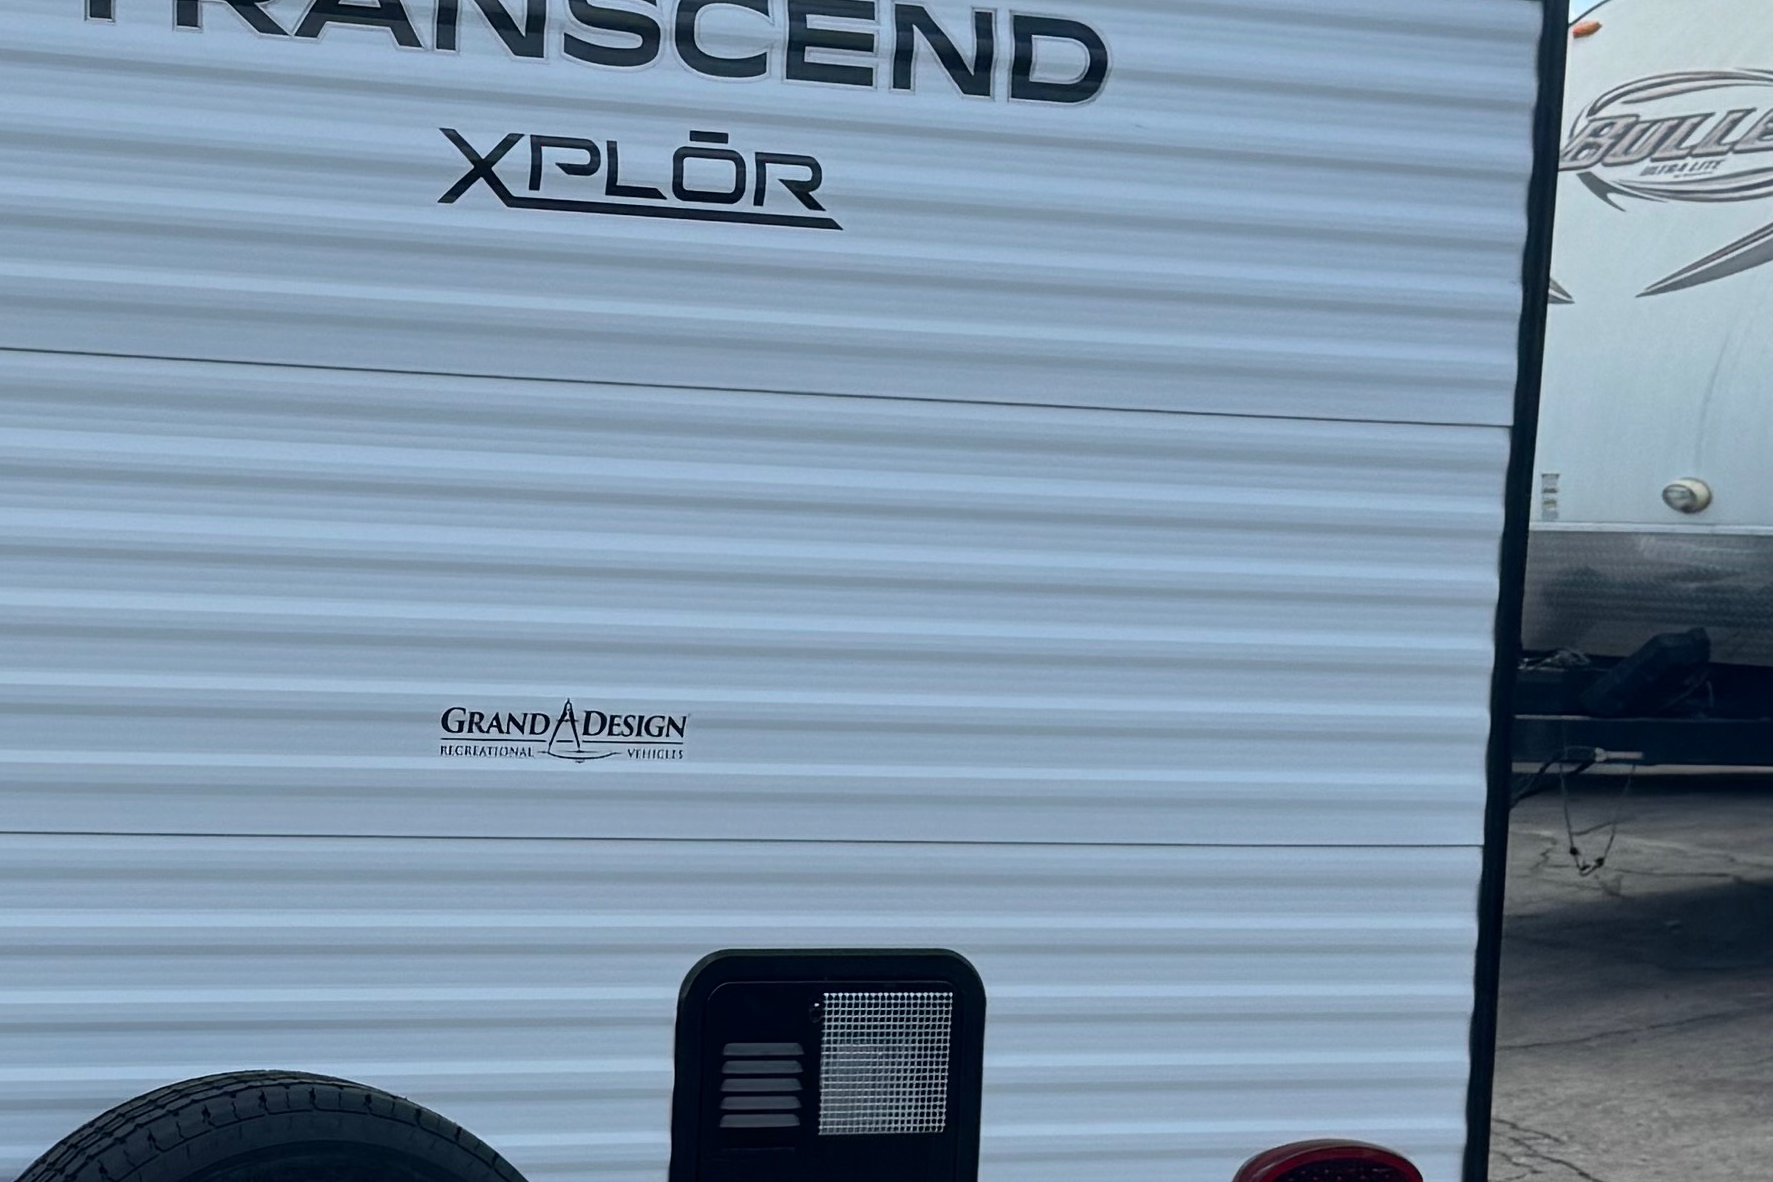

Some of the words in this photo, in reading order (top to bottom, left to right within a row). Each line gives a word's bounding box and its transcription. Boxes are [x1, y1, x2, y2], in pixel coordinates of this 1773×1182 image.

[440, 706, 551, 735] GRAND
[582, 710, 687, 738] DESIGN
[439, 744, 535, 758] RECREATIONAL
[627, 748, 684, 760] VEHICLES
